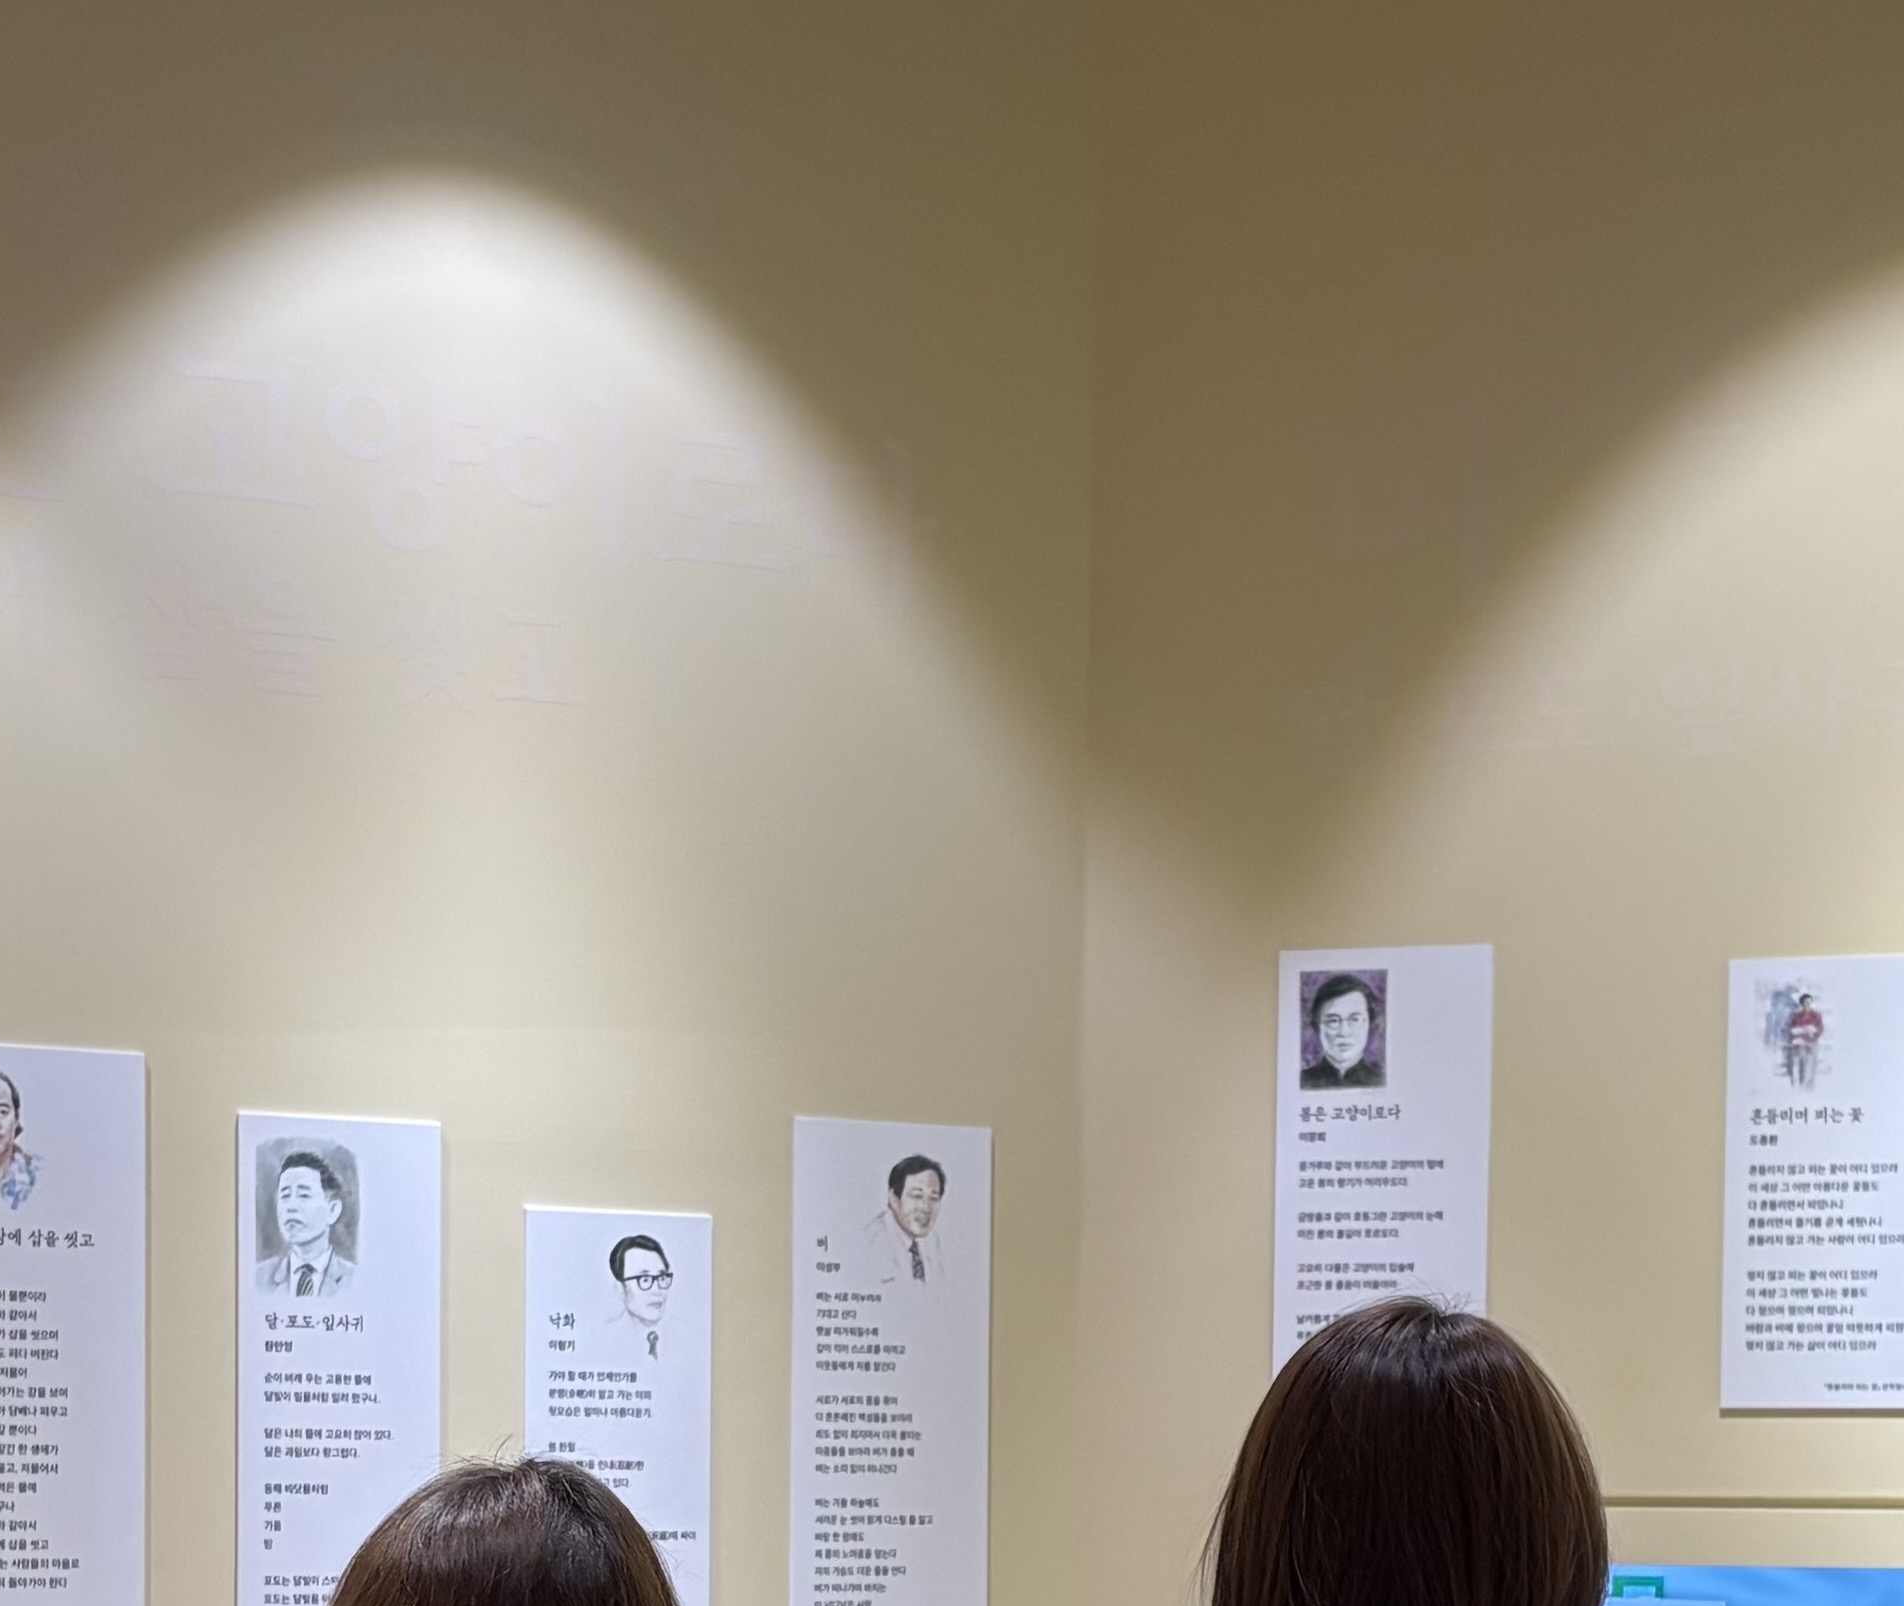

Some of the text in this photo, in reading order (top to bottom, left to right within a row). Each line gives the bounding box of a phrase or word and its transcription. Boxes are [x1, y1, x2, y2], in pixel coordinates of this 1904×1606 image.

[1298, 1103, 1402, 1123] 봄은 고양이로다
[27, 1228, 60, 1248] 삽을
[63, 1230, 95, 1249] 씻고
[549, 1312, 576, 1331] 낙화
